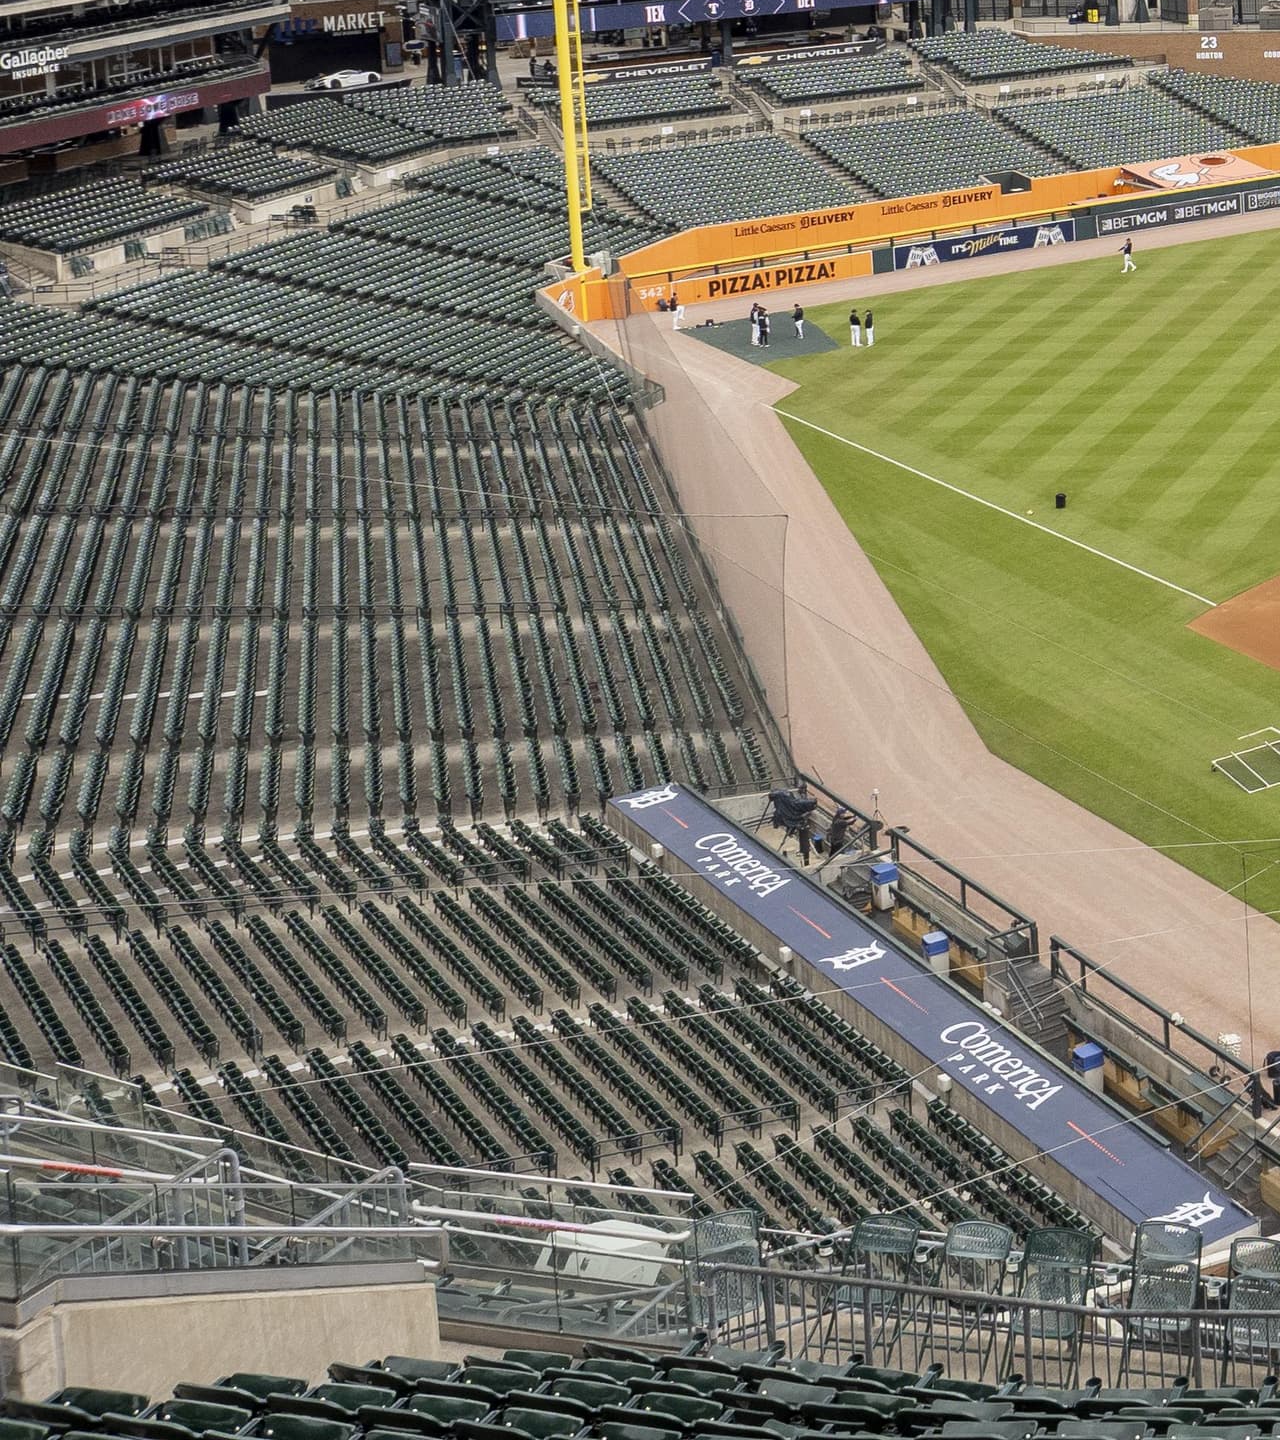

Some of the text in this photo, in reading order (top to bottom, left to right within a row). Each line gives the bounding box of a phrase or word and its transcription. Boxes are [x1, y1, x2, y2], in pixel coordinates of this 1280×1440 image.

[323, 11, 386, 33] MARKET
[645, 5, 665, 22] TEX
[1201, 37, 1217, 49] 23
[0, 44, 70, 71] Gallagher
[12, 63, 60, 81] INSURANCE
[881, 191, 993, 216] Little Caesars DELIVERY
[1184, 199, 1237, 218] BETMGM
[735, 211, 855, 238] Little Caesars DELIVERY
[1113, 210, 1167, 229] BETMGM
[952, 231, 1018, 258] IT'S Miller TIME
[709, 262, 836, 297] PIZZA! PIZZA!
[697, 856, 741, 890] PARK
[947, 1052, 1006, 1096] PARK
